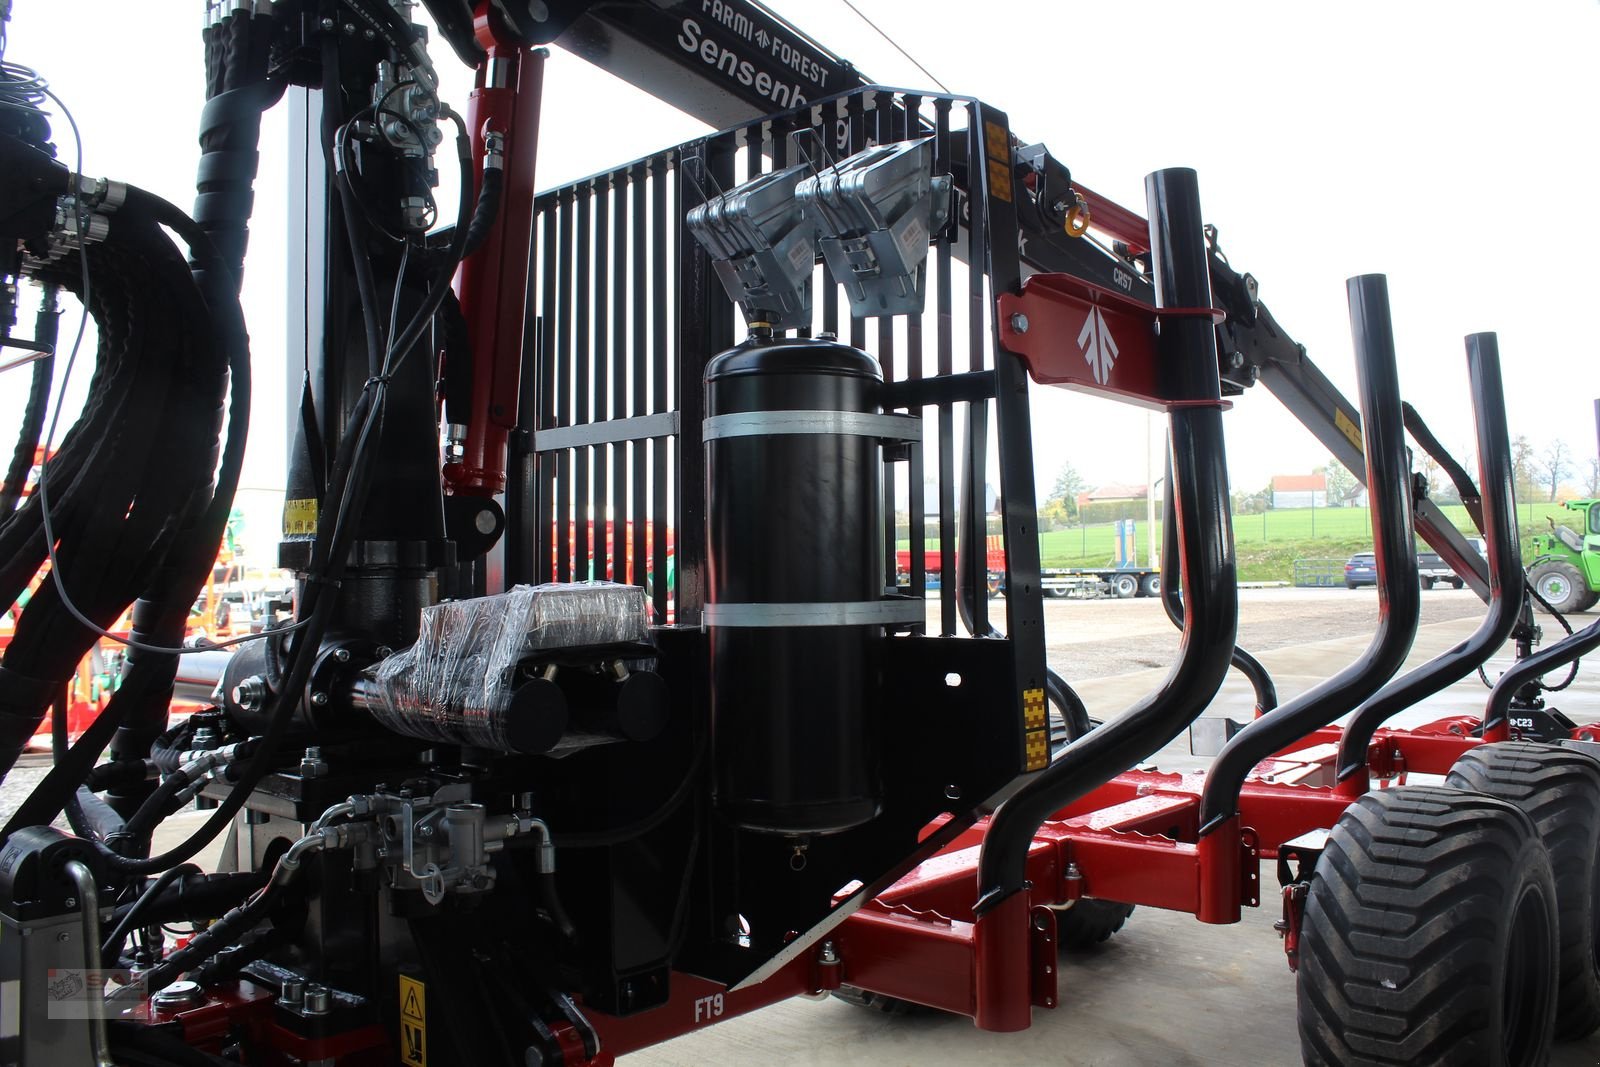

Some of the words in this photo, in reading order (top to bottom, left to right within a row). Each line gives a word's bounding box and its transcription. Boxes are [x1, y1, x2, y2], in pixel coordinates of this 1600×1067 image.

[702, 0, 754, 41] FARMI
[771, 36, 829, 88] FOREST
[695, 993, 724, 1023] FT9
